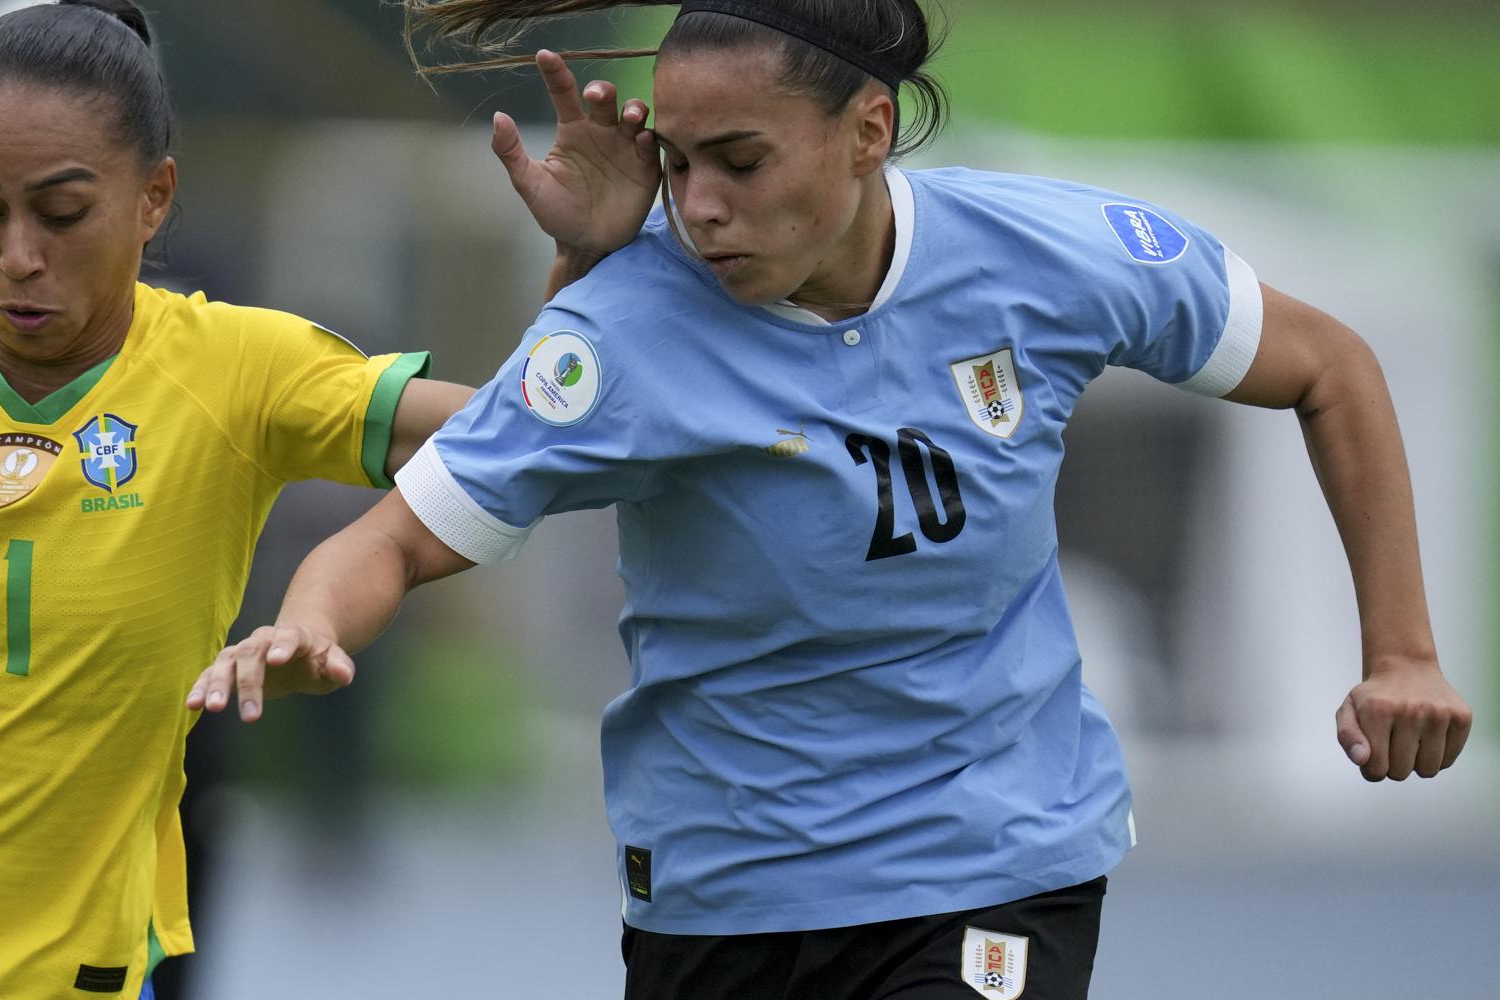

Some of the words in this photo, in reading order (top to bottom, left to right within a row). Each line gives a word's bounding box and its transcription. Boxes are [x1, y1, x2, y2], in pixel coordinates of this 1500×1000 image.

[1124, 210, 1157, 256] VIBRA
[535, 372, 548, 387] COPA
[980, 369, 996, 400] AUF
[96, 444, 119, 456] CBF
[81, 493, 144, 513] BRASIL
[845, 427, 967, 561] 20
[988, 946, 1002, 970] AUF
